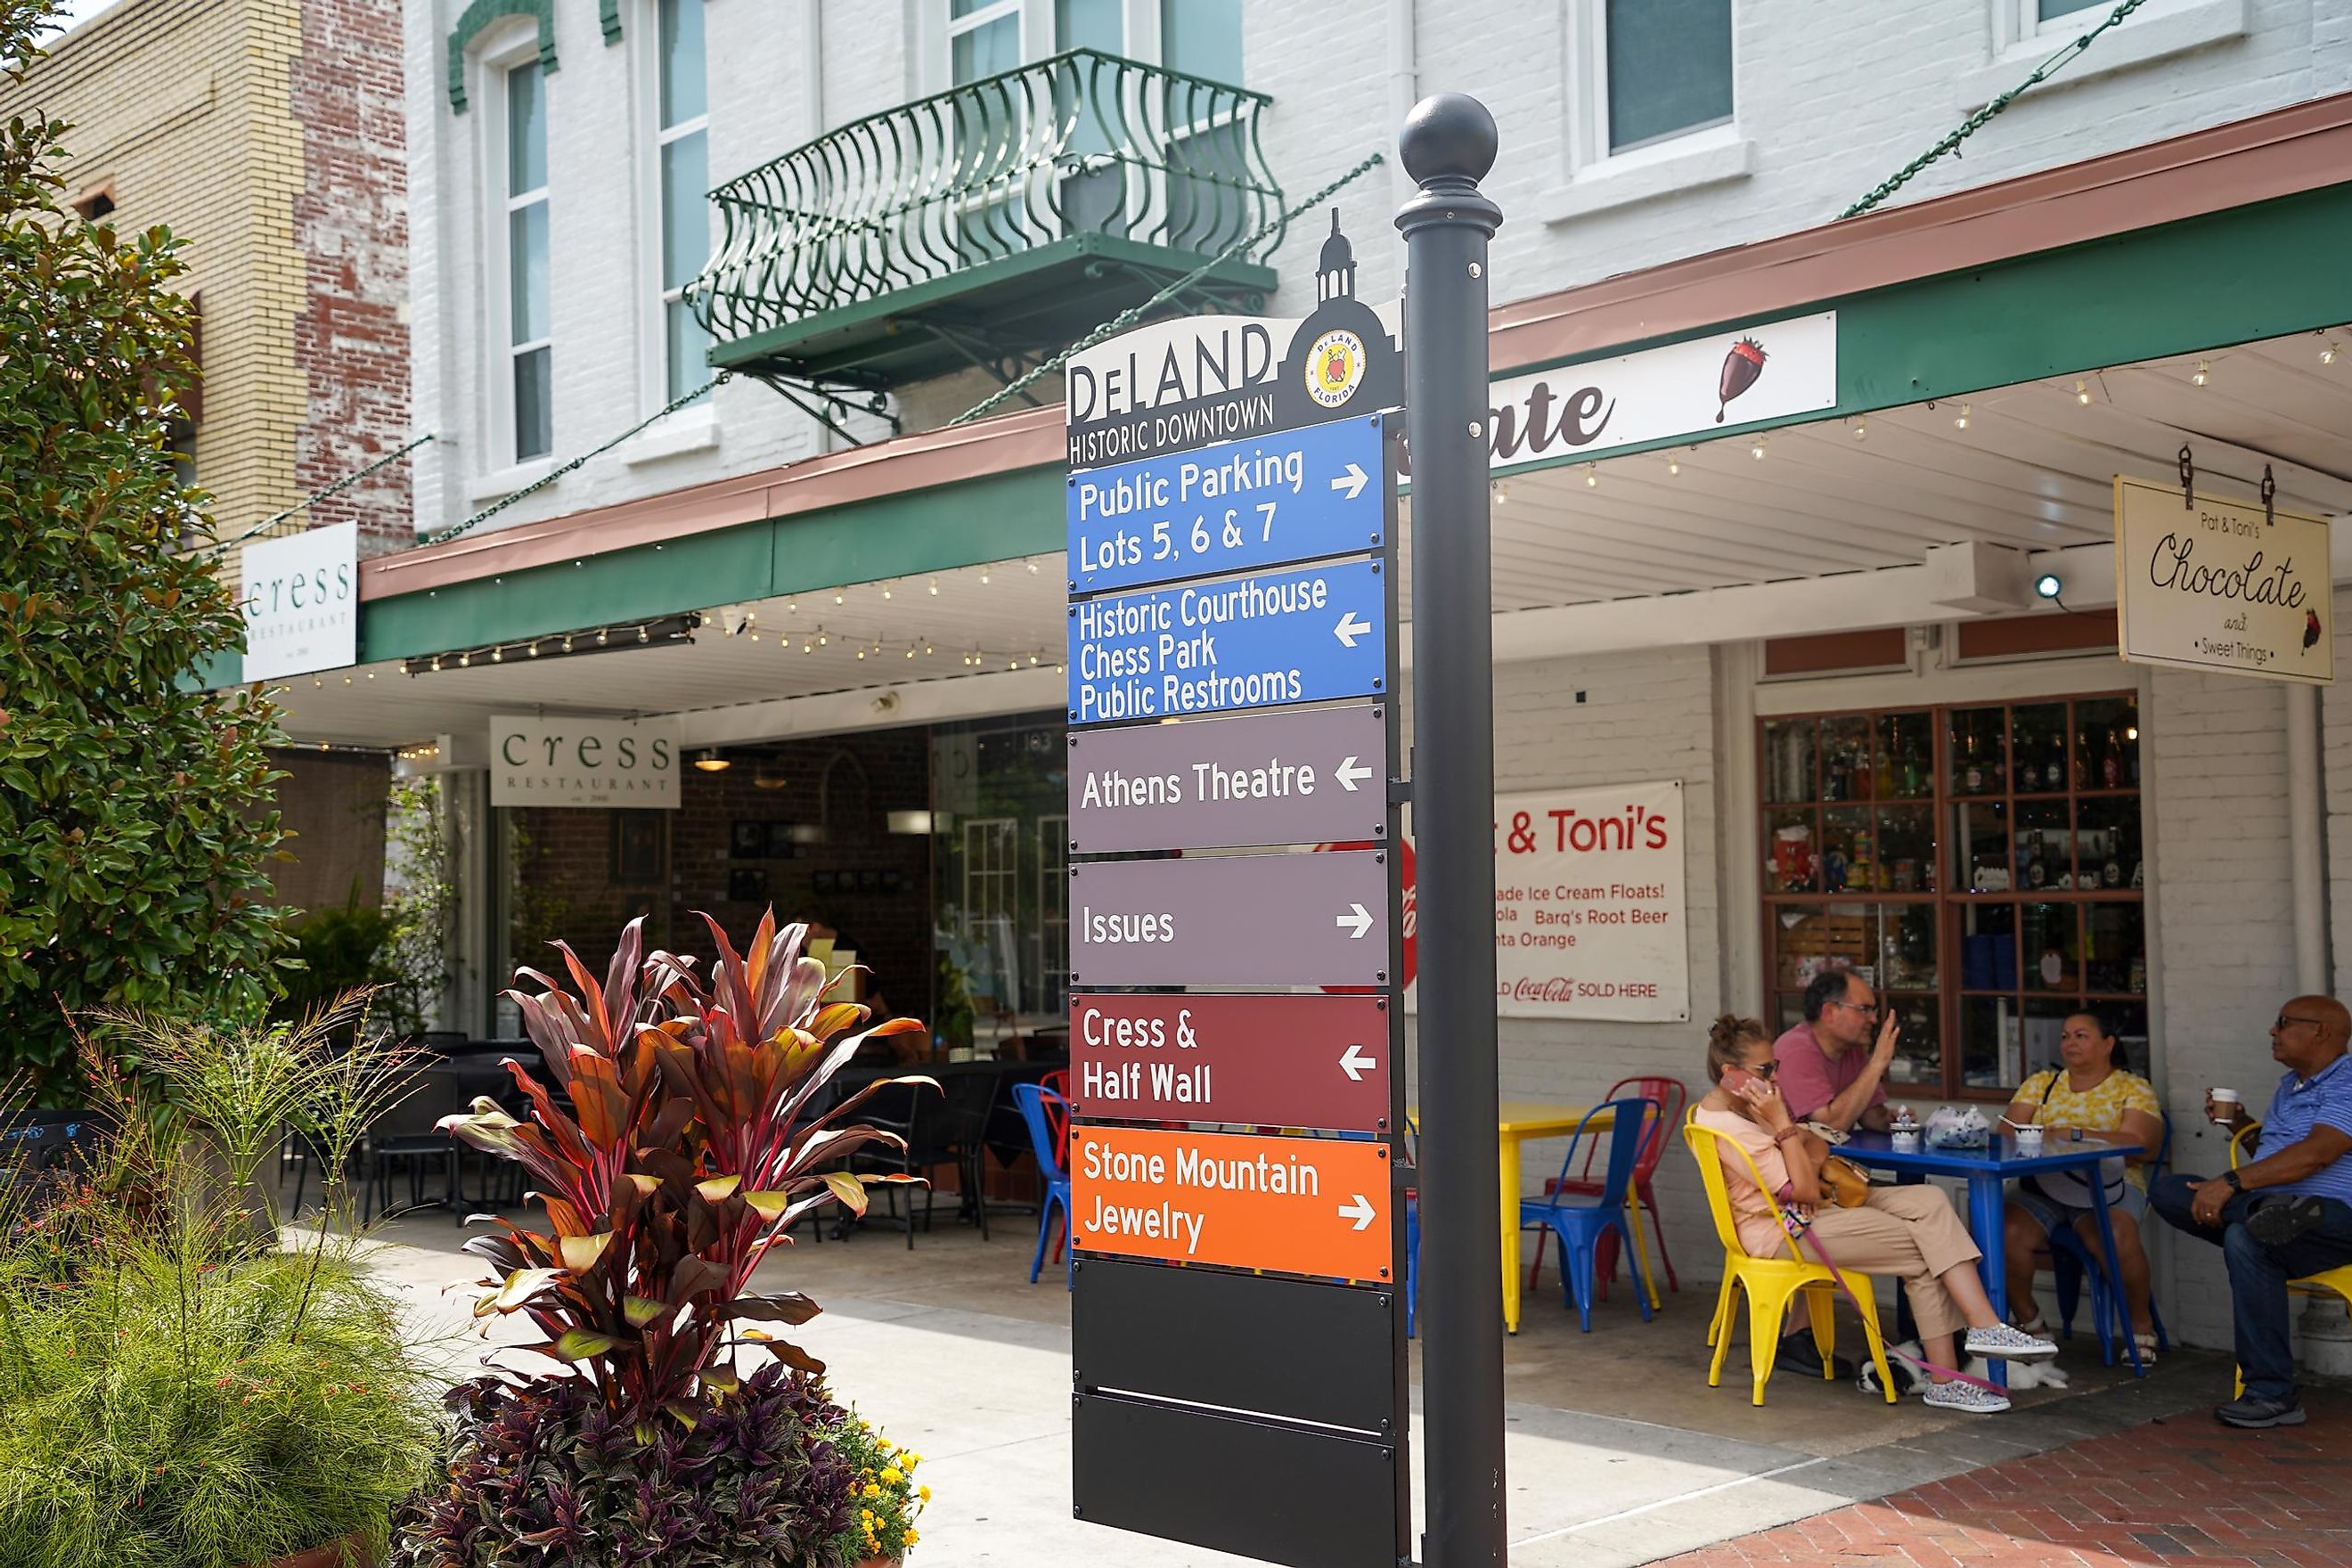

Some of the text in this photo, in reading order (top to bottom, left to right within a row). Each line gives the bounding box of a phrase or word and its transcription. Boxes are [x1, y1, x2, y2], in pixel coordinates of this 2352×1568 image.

[1314, 384, 1355, 404] FLORIDA
[1070, 394, 1274, 464] HISTORIC DOWNTOWN
[1080, 449, 1304, 521] Public Parking
[1080, 502, 1278, 573] Lots 5, 6 & 7
[2201, 511, 2260, 540] Pat & Toni's
[249, 563, 349, 617] cress
[2150, 533, 2307, 609] Chocolate
[250, 612, 347, 641] RESTAURANT
[1079, 578, 1328, 641] Historic Courthouse
[2224, 612, 2248, 632] and
[1080, 629, 1218, 682] Chess Park
[2202, 637, 2268, 666] Sweet Things
[1081, 668, 1303, 721] Public Restrooms
[502, 732, 670, 772] cress
[507, 776, 669, 792] RESTAURANT
[1081, 757, 1316, 809] Athens Theatre
[1507, 811, 1537, 854] &
[1548, 804, 1668, 853] Toni's
[1528, 886, 1550, 902] Ice
[1555, 884, 1605, 901] Cream
[1611, 883, 1666, 900] Floats!
[1082, 906, 1175, 944] Issues
[1534, 908, 1669, 927] Barq's Root Beer
[1521, 931, 1576, 950] Orange
[1578, 982, 1615, 998] SOLD
[1619, 983, 1658, 998] HERE
[1082, 1008, 1198, 1049] Cress &
[1082, 1061, 1212, 1104] Half Wall
[1082, 1140, 1319, 1197] Stone Mountain
[1083, 1195, 1205, 1255] Jewelry
